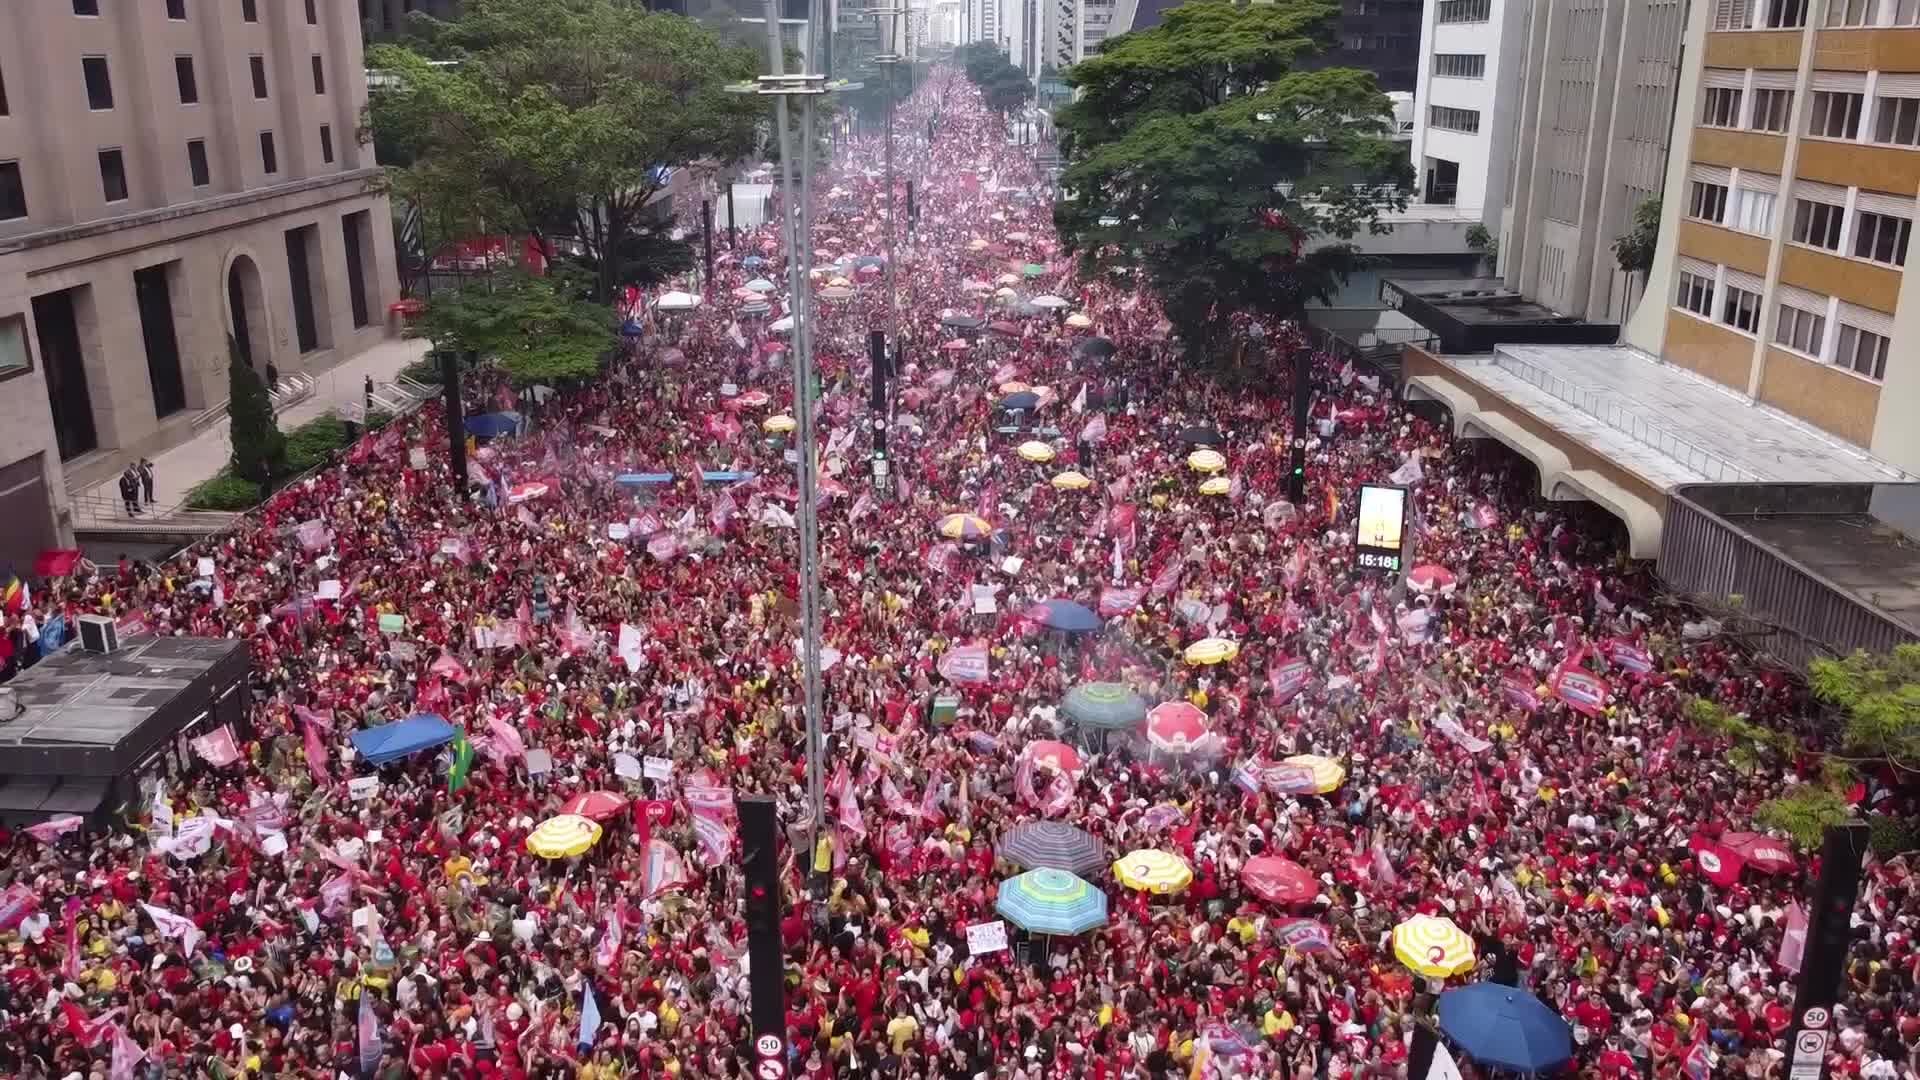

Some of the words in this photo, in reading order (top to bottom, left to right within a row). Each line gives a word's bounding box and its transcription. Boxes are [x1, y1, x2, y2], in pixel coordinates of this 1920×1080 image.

[1359, 553, 1392, 568] 15:18
[1807, 1012, 1825, 1022] 50
[761, 1040, 778, 1050] 50
